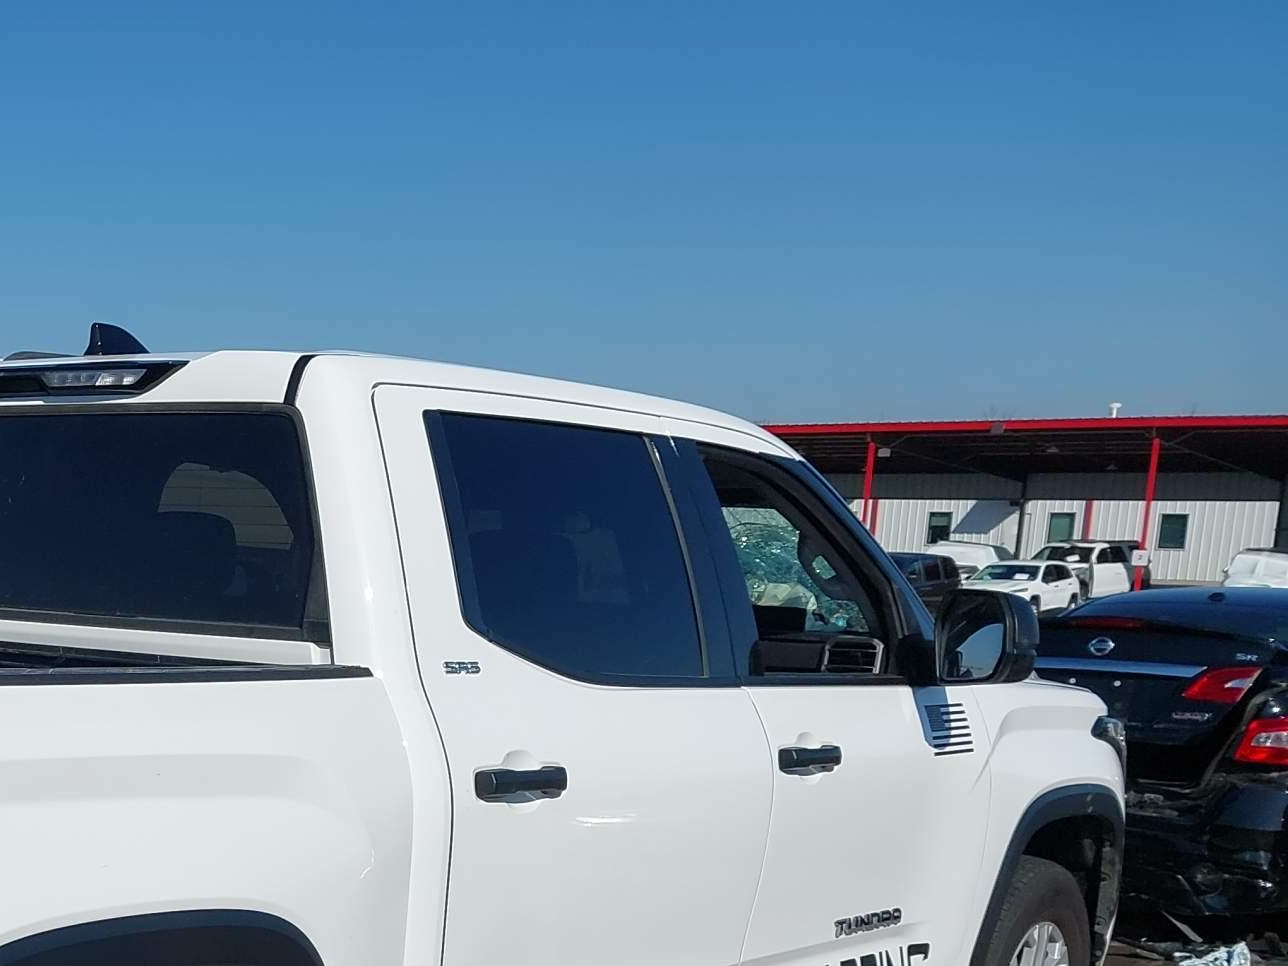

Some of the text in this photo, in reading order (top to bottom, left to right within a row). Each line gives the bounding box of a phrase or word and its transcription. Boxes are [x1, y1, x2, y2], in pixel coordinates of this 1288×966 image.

[1236, 653, 1258, 661] SR
[443, 661, 481, 674] SR5
[834, 907, 902, 939] TUNDRA
